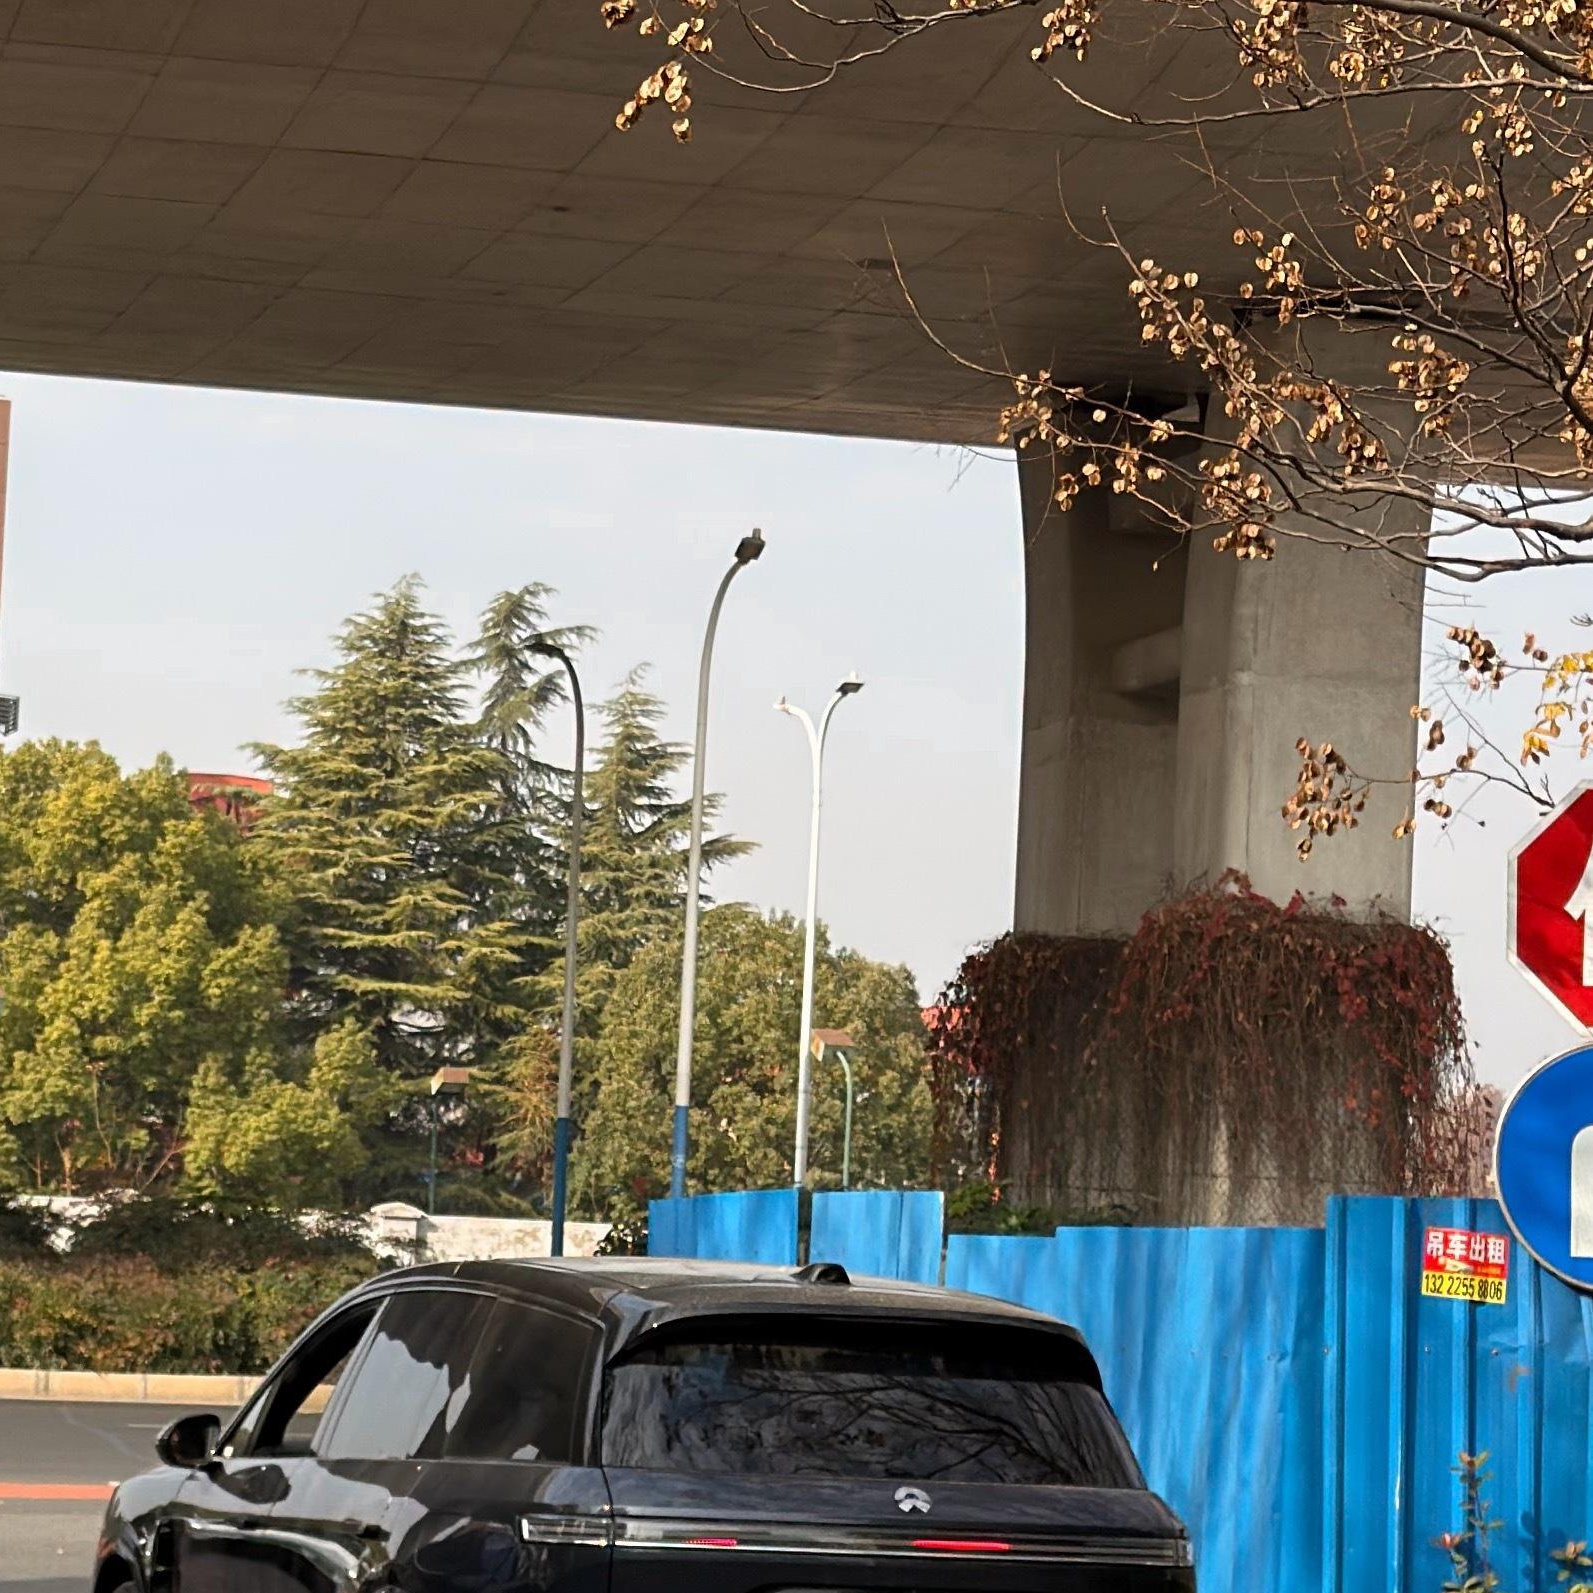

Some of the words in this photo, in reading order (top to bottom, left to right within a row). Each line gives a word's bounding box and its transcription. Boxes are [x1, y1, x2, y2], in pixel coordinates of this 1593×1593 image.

[1426, 1231, 1505, 1265] 吊车出租
[1424, 1274, 1444, 1294] 132
[1447, 1273, 1475, 1298] 2255
